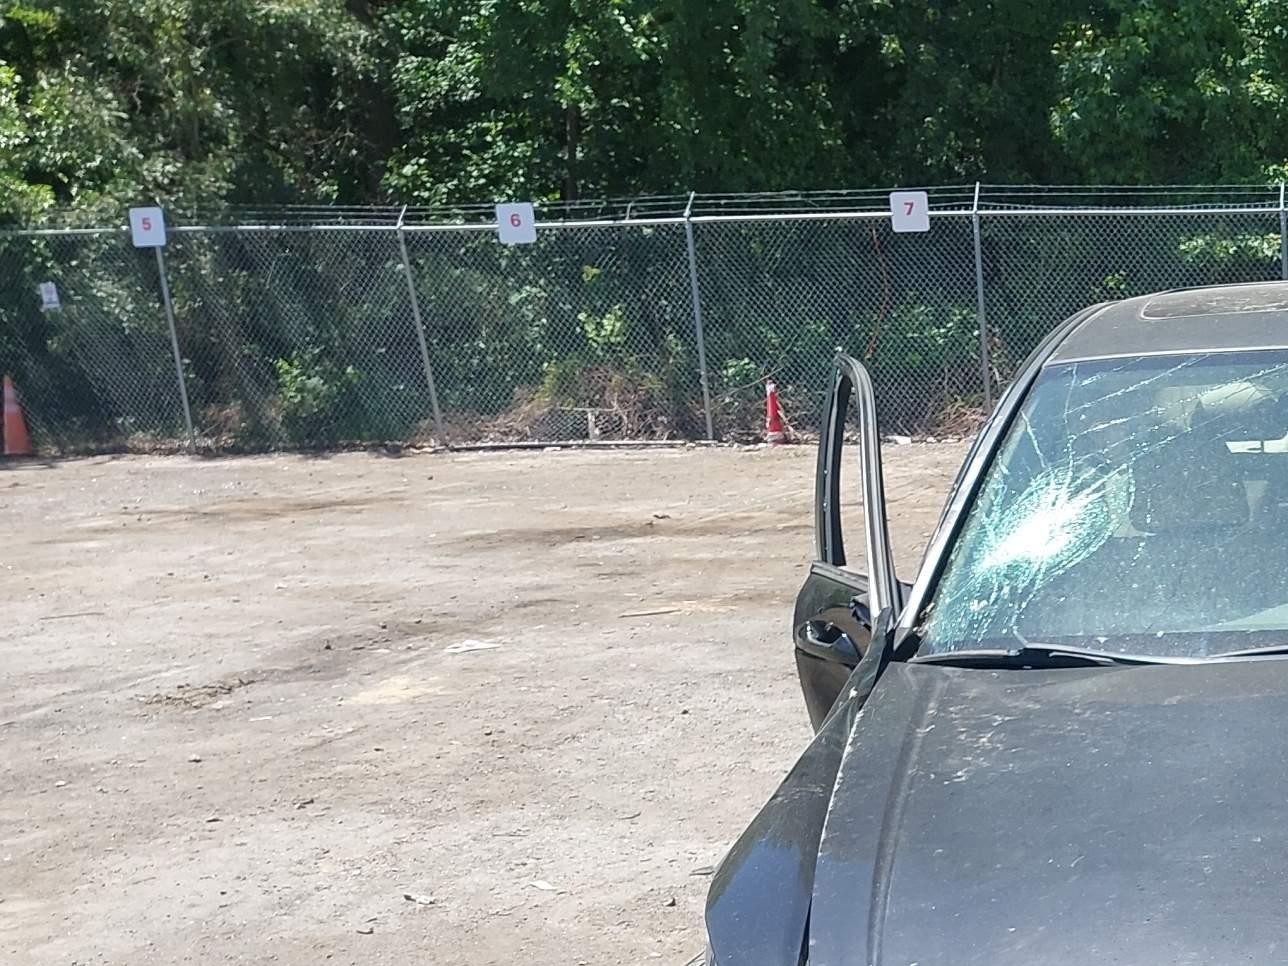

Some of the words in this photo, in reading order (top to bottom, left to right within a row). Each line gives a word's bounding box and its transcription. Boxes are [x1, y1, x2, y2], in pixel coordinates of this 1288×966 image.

[903, 201, 914, 216] 7
[141, 216, 152, 231] 5
[510, 213, 522, 228] 6
